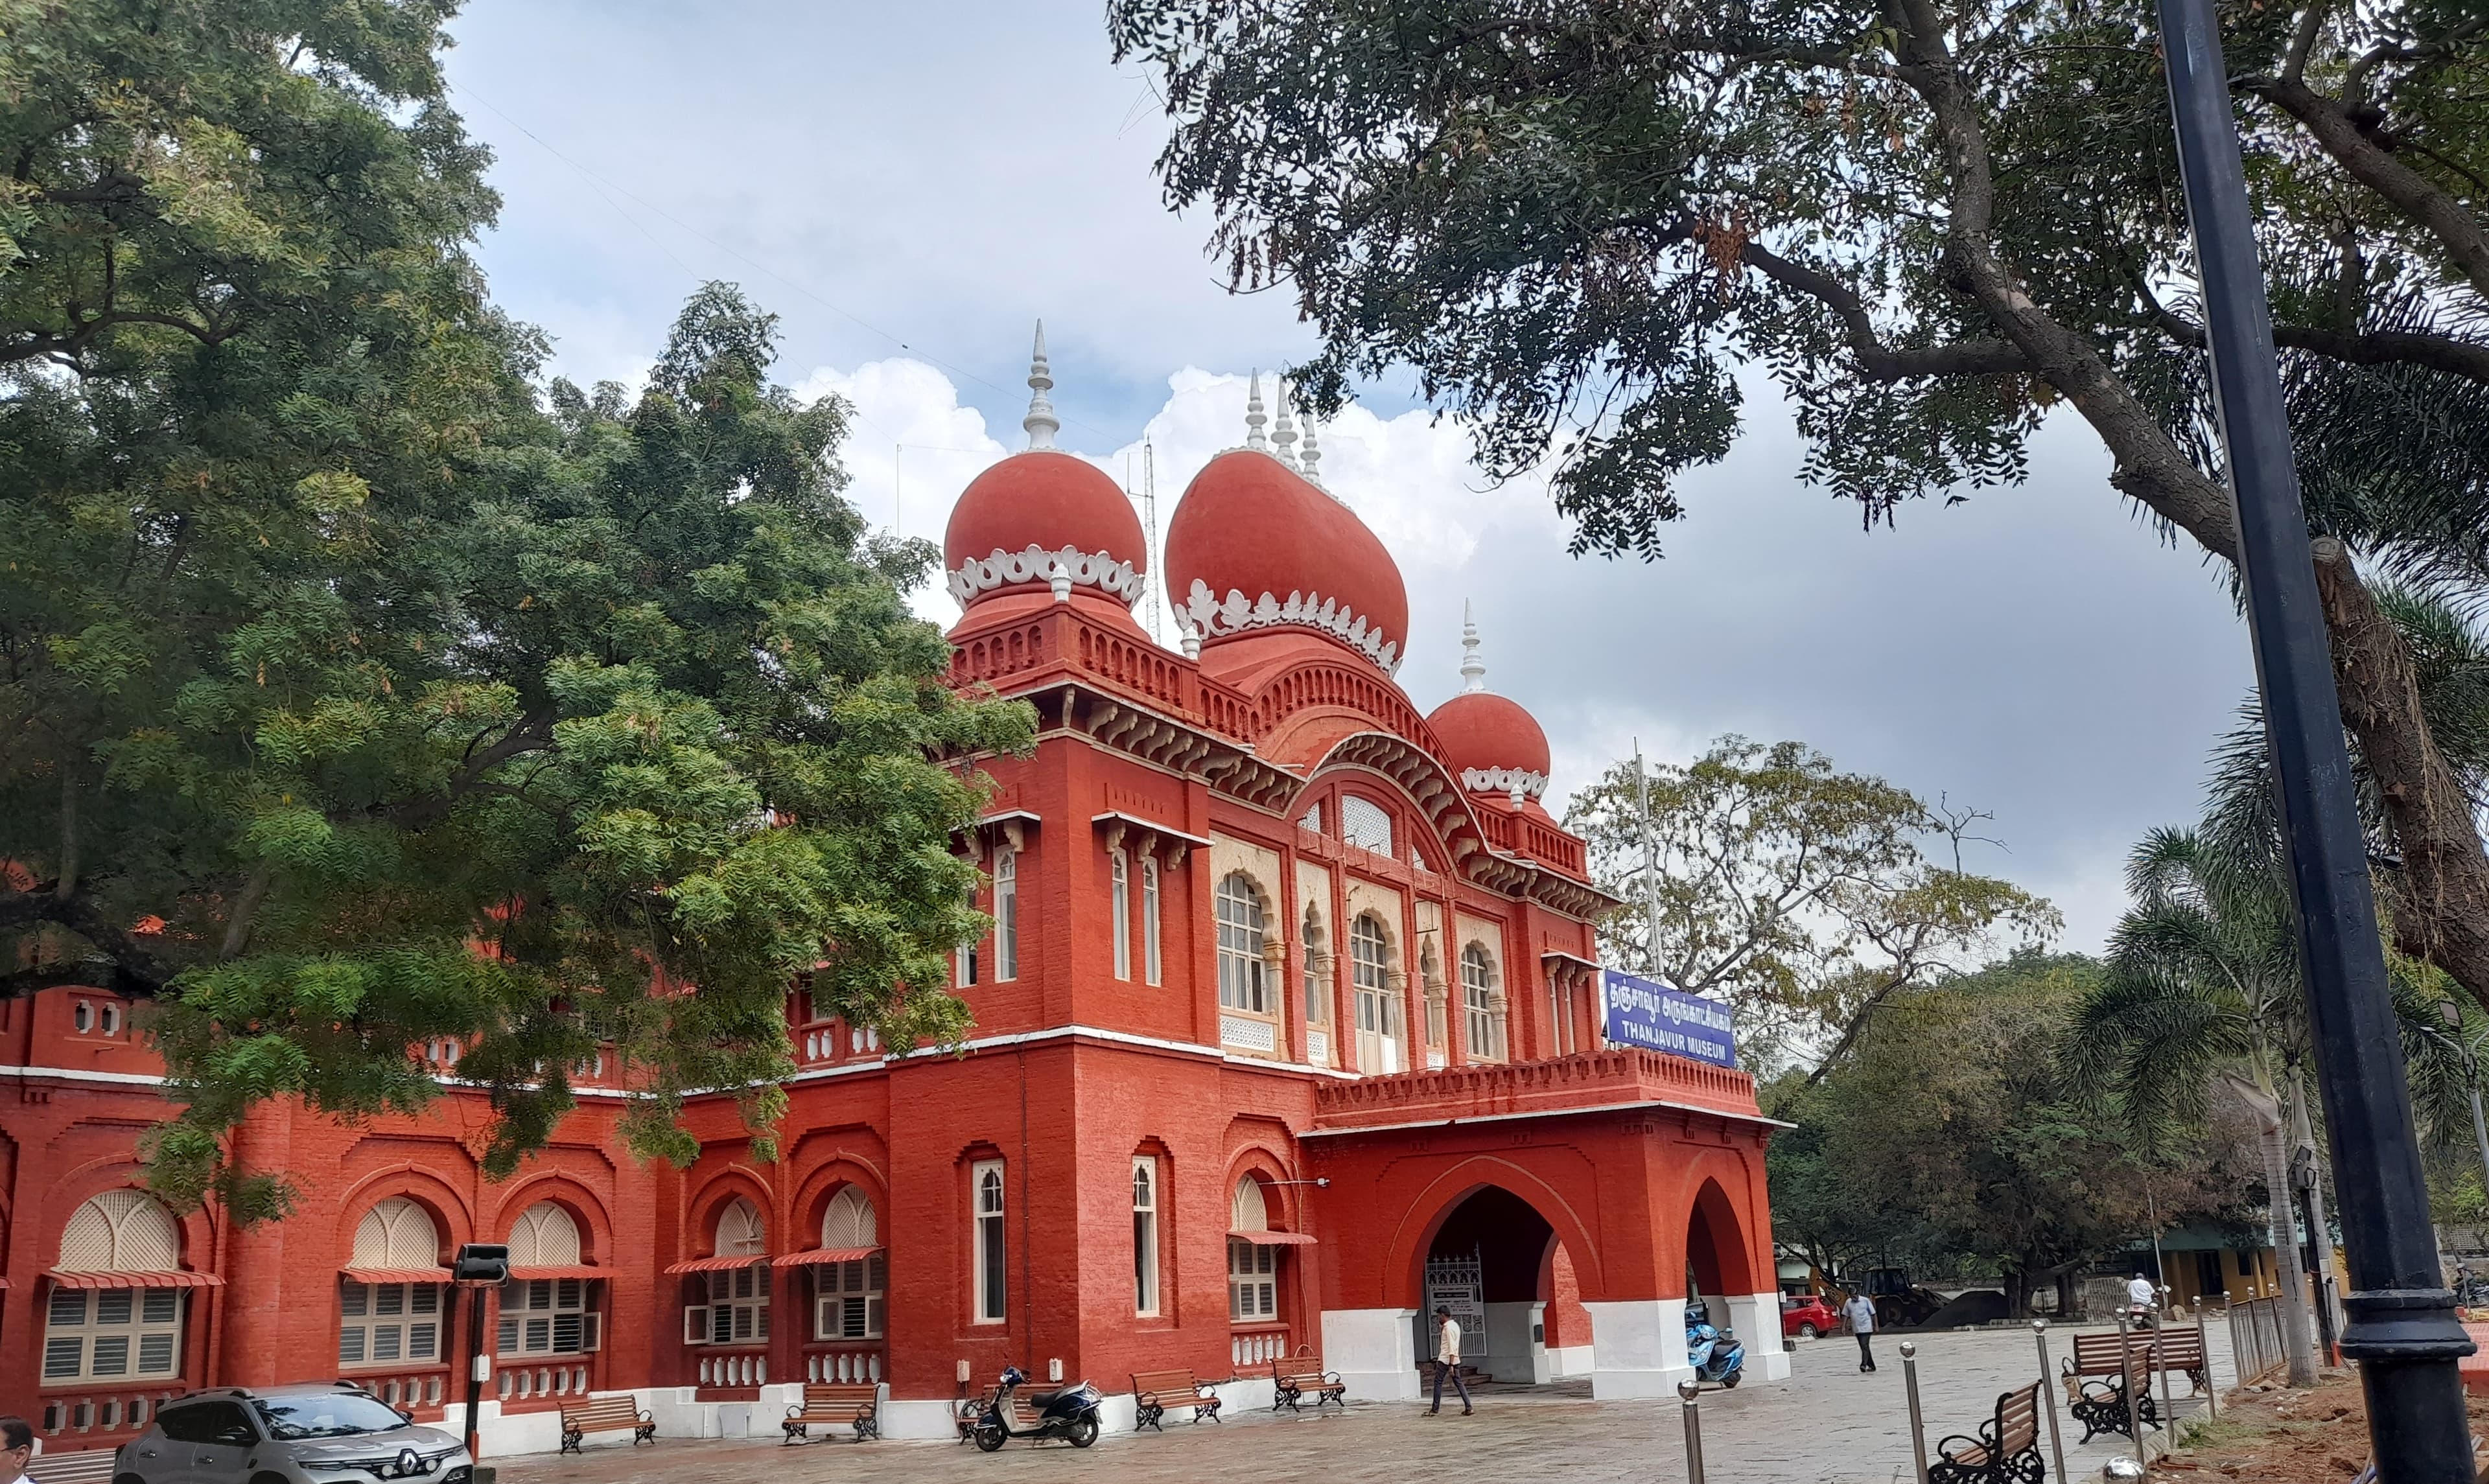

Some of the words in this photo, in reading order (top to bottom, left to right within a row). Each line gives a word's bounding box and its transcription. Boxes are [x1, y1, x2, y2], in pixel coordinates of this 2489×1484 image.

[1610, 977, 1660, 1024] தஞ்சாவூர்
[1622, 1019, 1686, 1051] THANJAVUR
[1687, 1037, 1726, 1061] MUSEUM
